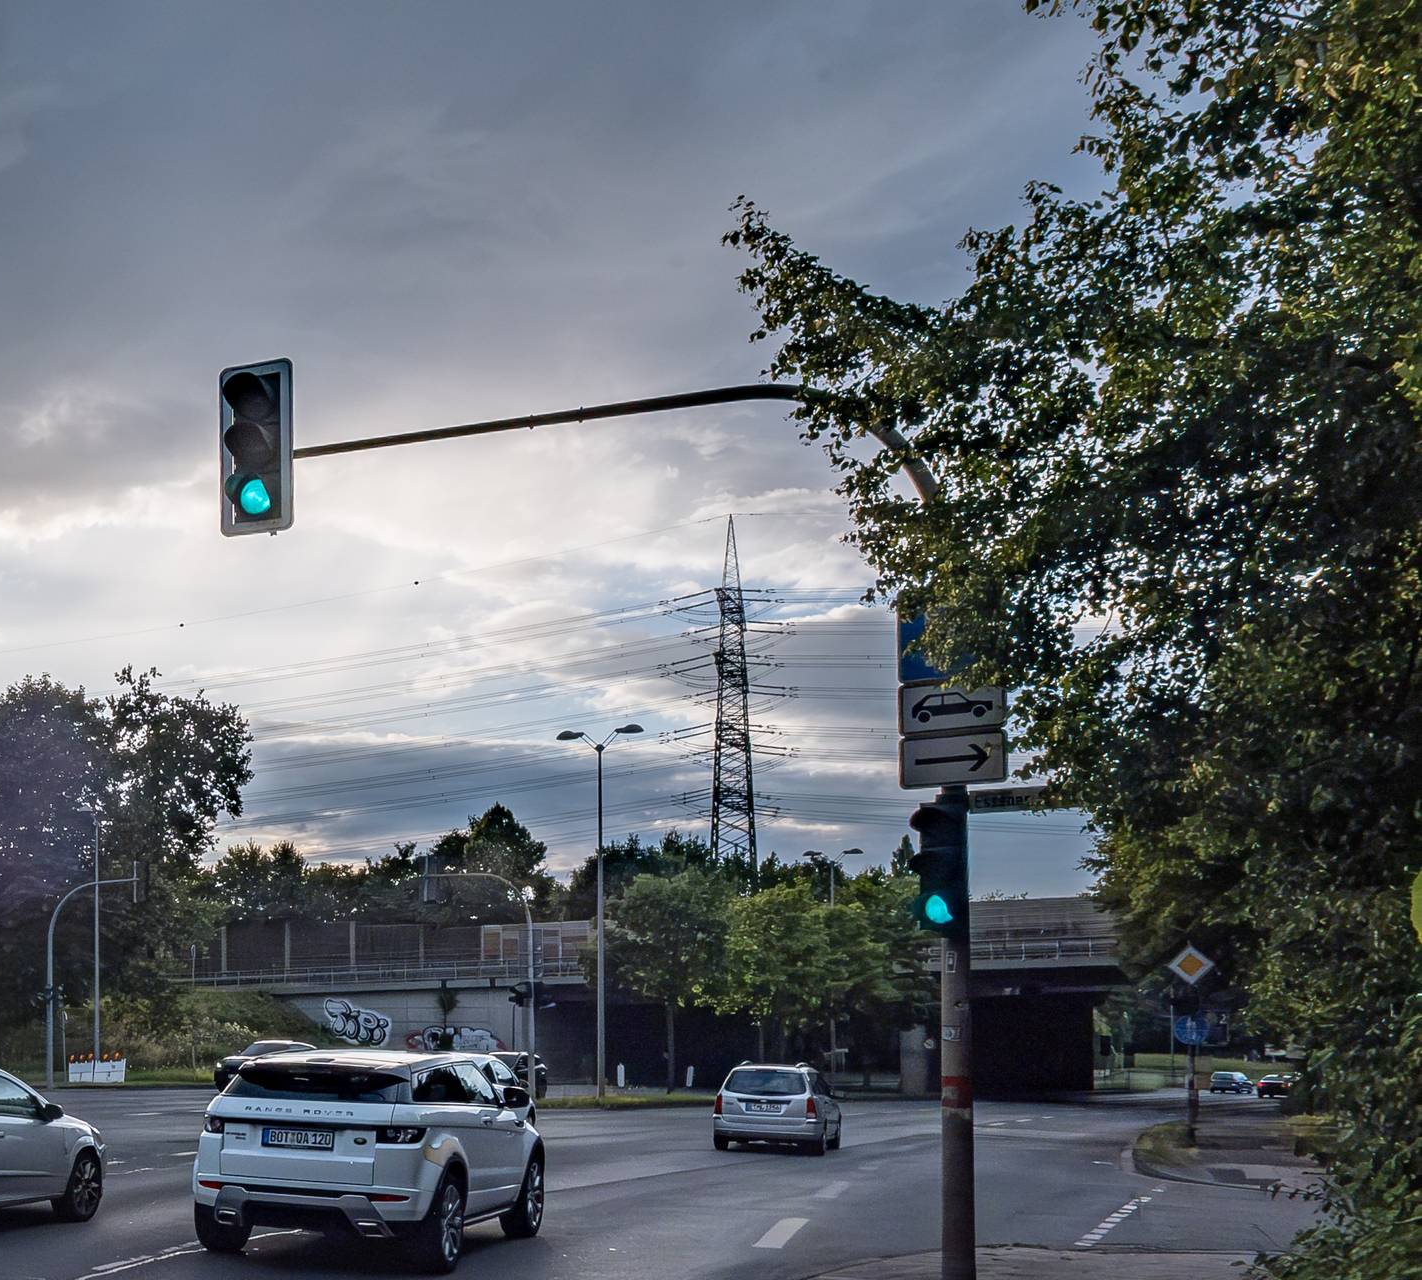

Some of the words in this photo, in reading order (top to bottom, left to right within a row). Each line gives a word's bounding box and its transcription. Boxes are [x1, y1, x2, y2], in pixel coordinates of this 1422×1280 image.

[244, 1105, 293, 1114] RANGE
[302, 1108, 354, 1117] ROVER
[270, 1130, 289, 1143] BOT
[312, 1132, 332, 1146] 120
